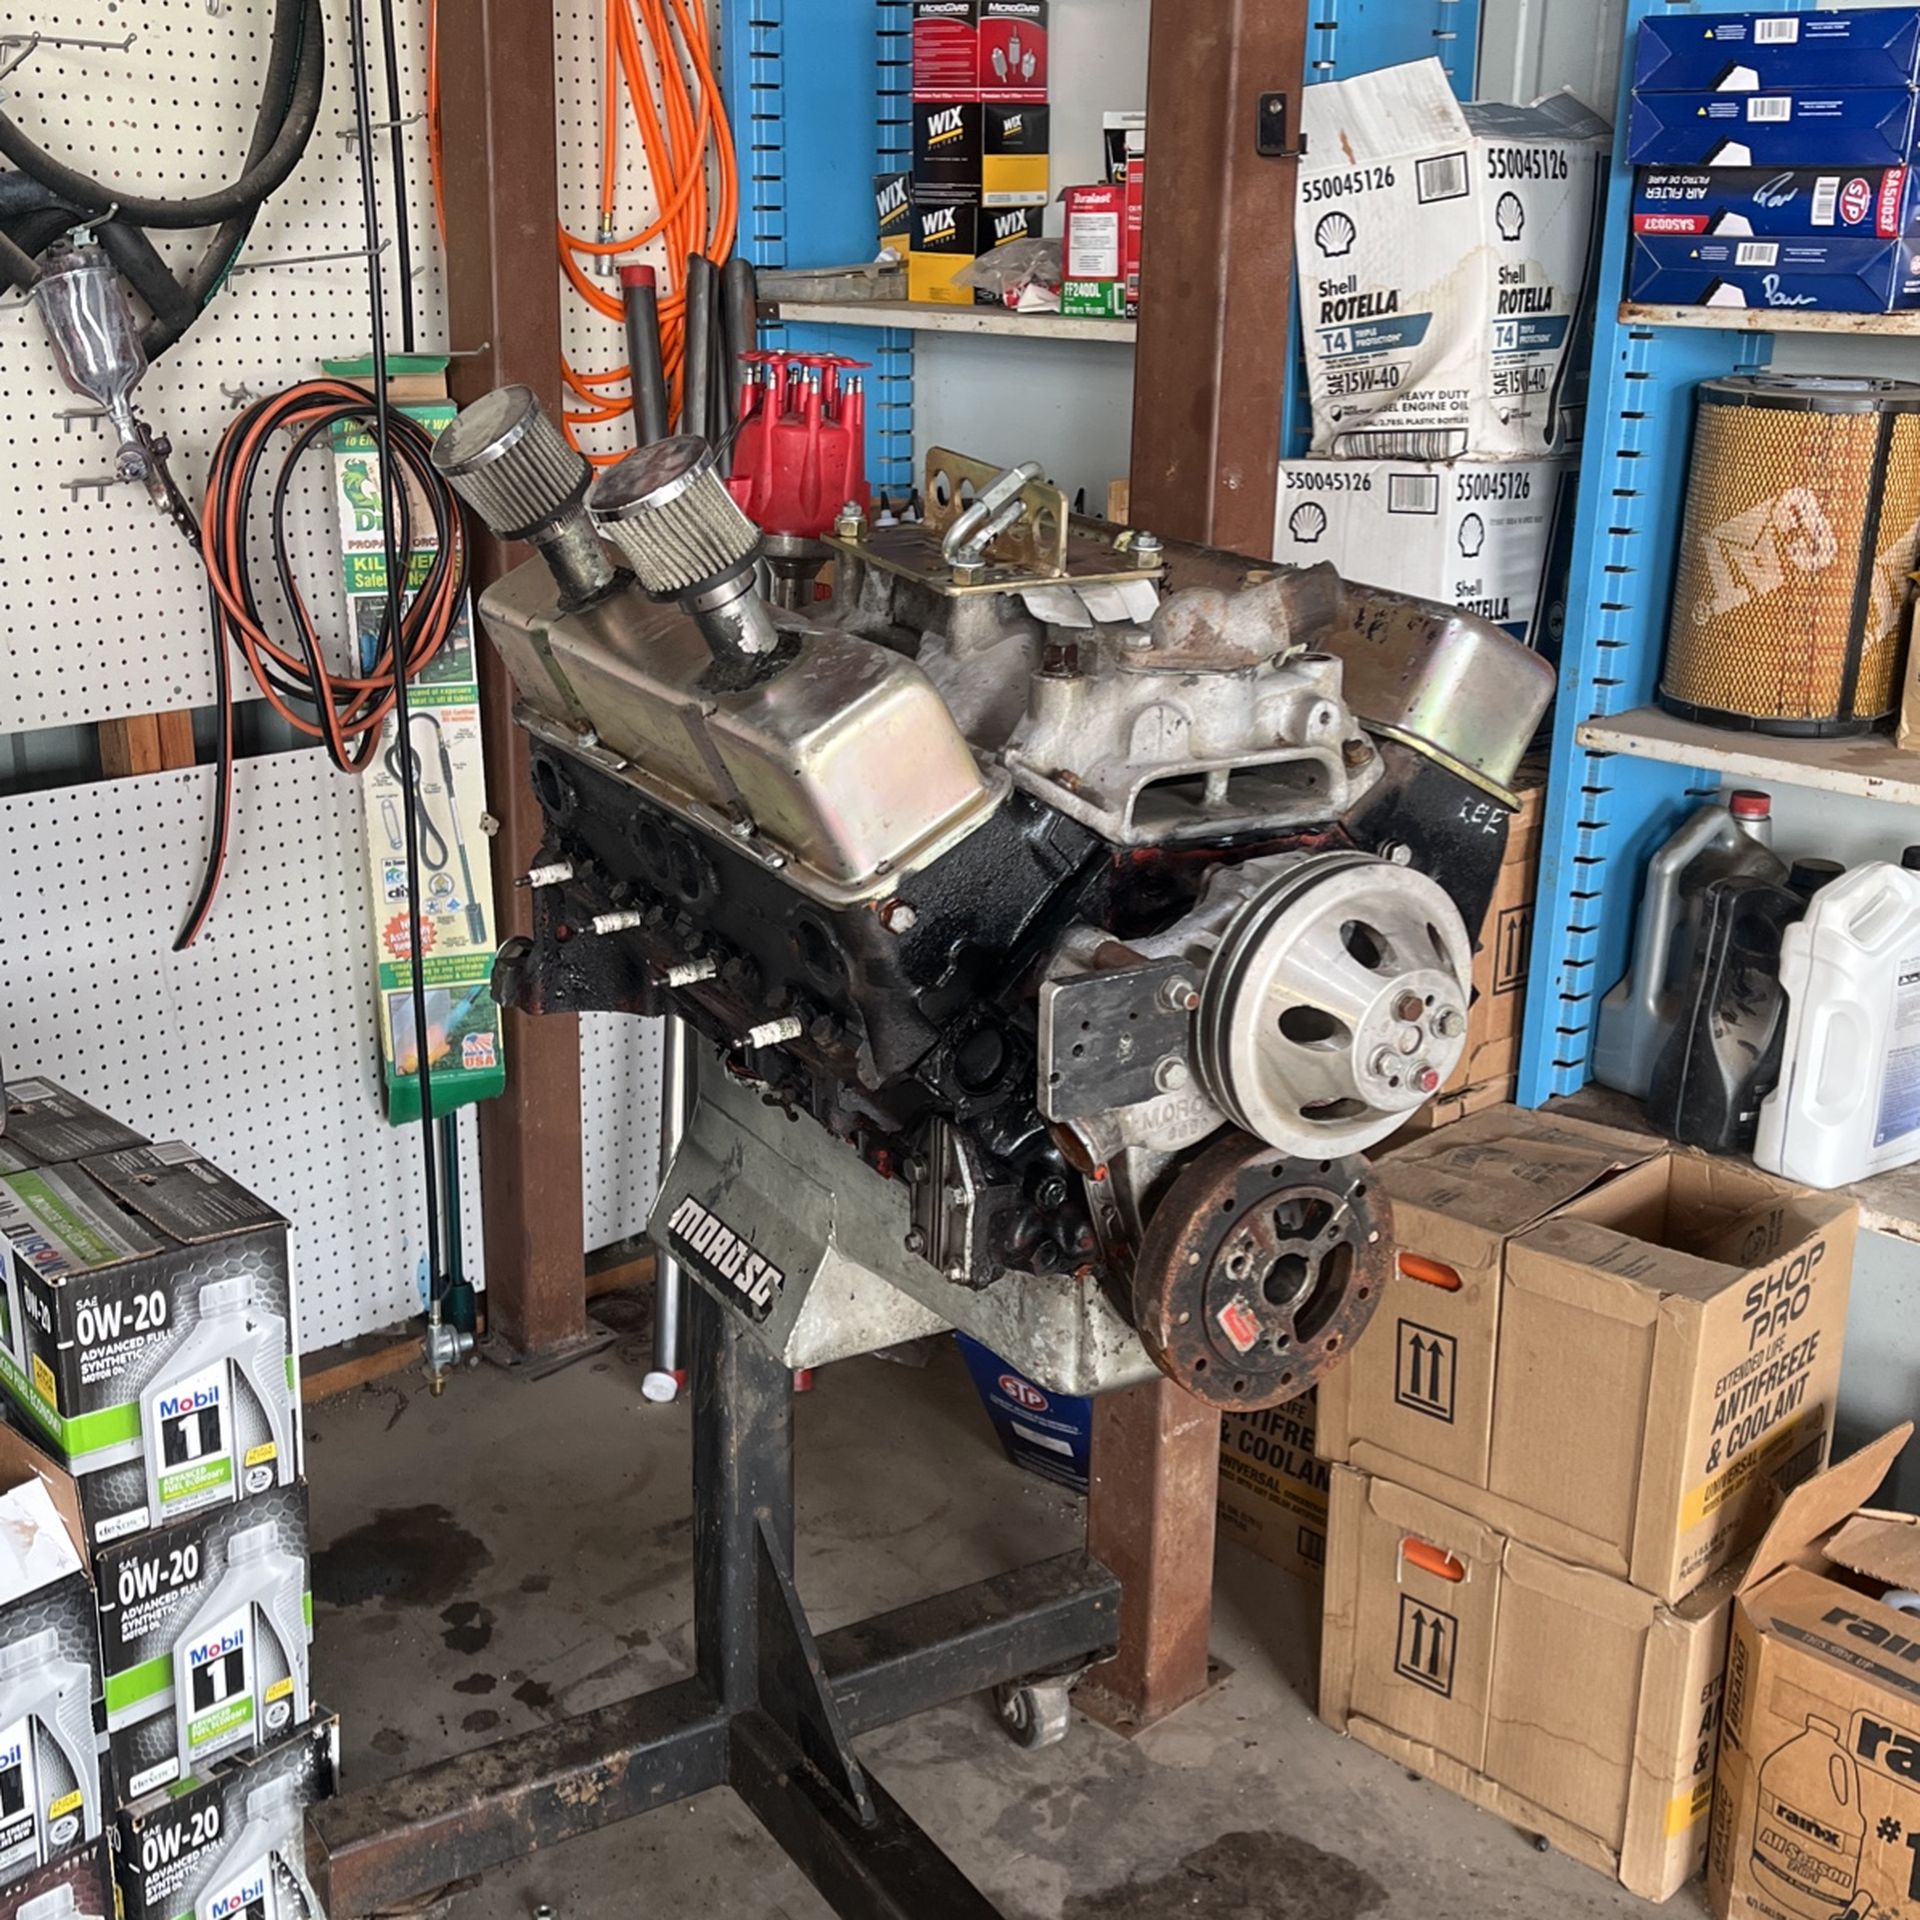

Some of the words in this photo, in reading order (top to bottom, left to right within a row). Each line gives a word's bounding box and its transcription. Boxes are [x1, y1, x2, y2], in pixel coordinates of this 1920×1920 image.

[927, 105, 963, 136] WIX
[1003, 114, 1023, 131] WIX
[1487, 148, 1568, 180] 550045126
[1302, 166, 1396, 203] 550045126
[1645, 187, 1683, 200] FILTER
[1648, 175, 1667, 185] AIRE
[1668, 175, 1680, 185] DE
[1682, 175, 1710, 185] FILTRO
[1686, 187, 1708, 200] AIR
[876, 177, 908, 217] WIX
[1845, 182, 1866, 221] STP
[1881, 169, 1902, 233] SA50037
[922, 207, 957, 235] WIX
[994, 208, 1028, 238] WIX
[1644, 217, 1696, 231] SA50037
[1318, 274, 1357, 298] Shell
[1498, 264, 1526, 285] Shell
[1320, 289, 1399, 324] ROTELLA
[1498, 286, 1553, 314] ROTELLA
[1322, 332, 1347, 353] T4
[1496, 325, 1514, 347] T4
[1327, 373, 1344, 395] SAE
[1344, 366, 1399, 393] 15W-40
[1438, 390, 1469, 399] DUTY
[1494, 371, 1509, 394] SAE
[1509, 368, 1546, 393] 15W-40
[1402, 402, 1447, 412] ENGINE
[1450, 401, 1469, 411] OIL
[1286, 471, 1372, 491] 550045126
[1456, 472, 1530, 501] 550045126
[1455, 578, 1483, 598] Shell
[465, 1057, 494, 1067] USA
[12, 1234, 71, 1276] Mobil
[1742, 1241, 1826, 1323] SHOP
[76, 1295, 98, 1311] SAE
[76, 1290, 167, 1346] 0W-20
[1749, 1284, 1810, 1352] PRO
[80, 1336, 145, 1363] ADVANCED
[146, 1328, 175, 1345] FULL
[81, 1348, 144, 1376] SYNTHETIC
[81, 1369, 112, 1385] MOTOR
[1714, 1349, 1764, 1399] EXTENDED
[1765, 1333, 1787, 1362] LIFE
[1005, 1380, 1041, 1405] STP
[1711, 1330, 1821, 1436] ANTIFREEZE
[160, 1385, 220, 1418] Mobil
[178, 1412, 202, 1460] 1
[1705, 1438, 1722, 1474] &
[1726, 1372, 1810, 1458] COOLANT
[1220, 1452, 1282, 1493] NIVERSAL
[1238, 1429, 1330, 1491] COOLAN
[118, 1556, 139, 1573] SAE
[118, 1545, 199, 1606] 0W-20
[121, 1590, 179, 1623] ADVANCED
[180, 1580, 205, 1597] FULL
[121, 1603, 178, 1633] SYNTHETIC
[122, 1626, 149, 1643] MOTOR
[190, 1629, 244, 1666] Mobil
[1802, 1633, 1827, 1649] THIS
[1856, 1657, 1875, 1670] UP
[207, 1656, 228, 1703] 1
[142, 1823, 161, 1841] SAE
[142, 1805, 219, 1872] 0W-20
[145, 1851, 200, 1887] ADVANCED
[201, 1839, 225, 1857] FULL
[1759, 1827, 1786, 1854] All
[1784, 1842, 1853, 1889] Season
[145, 1862, 200, 1896] SYNTHETIC
[212, 1878, 265, 1919] Mobil
